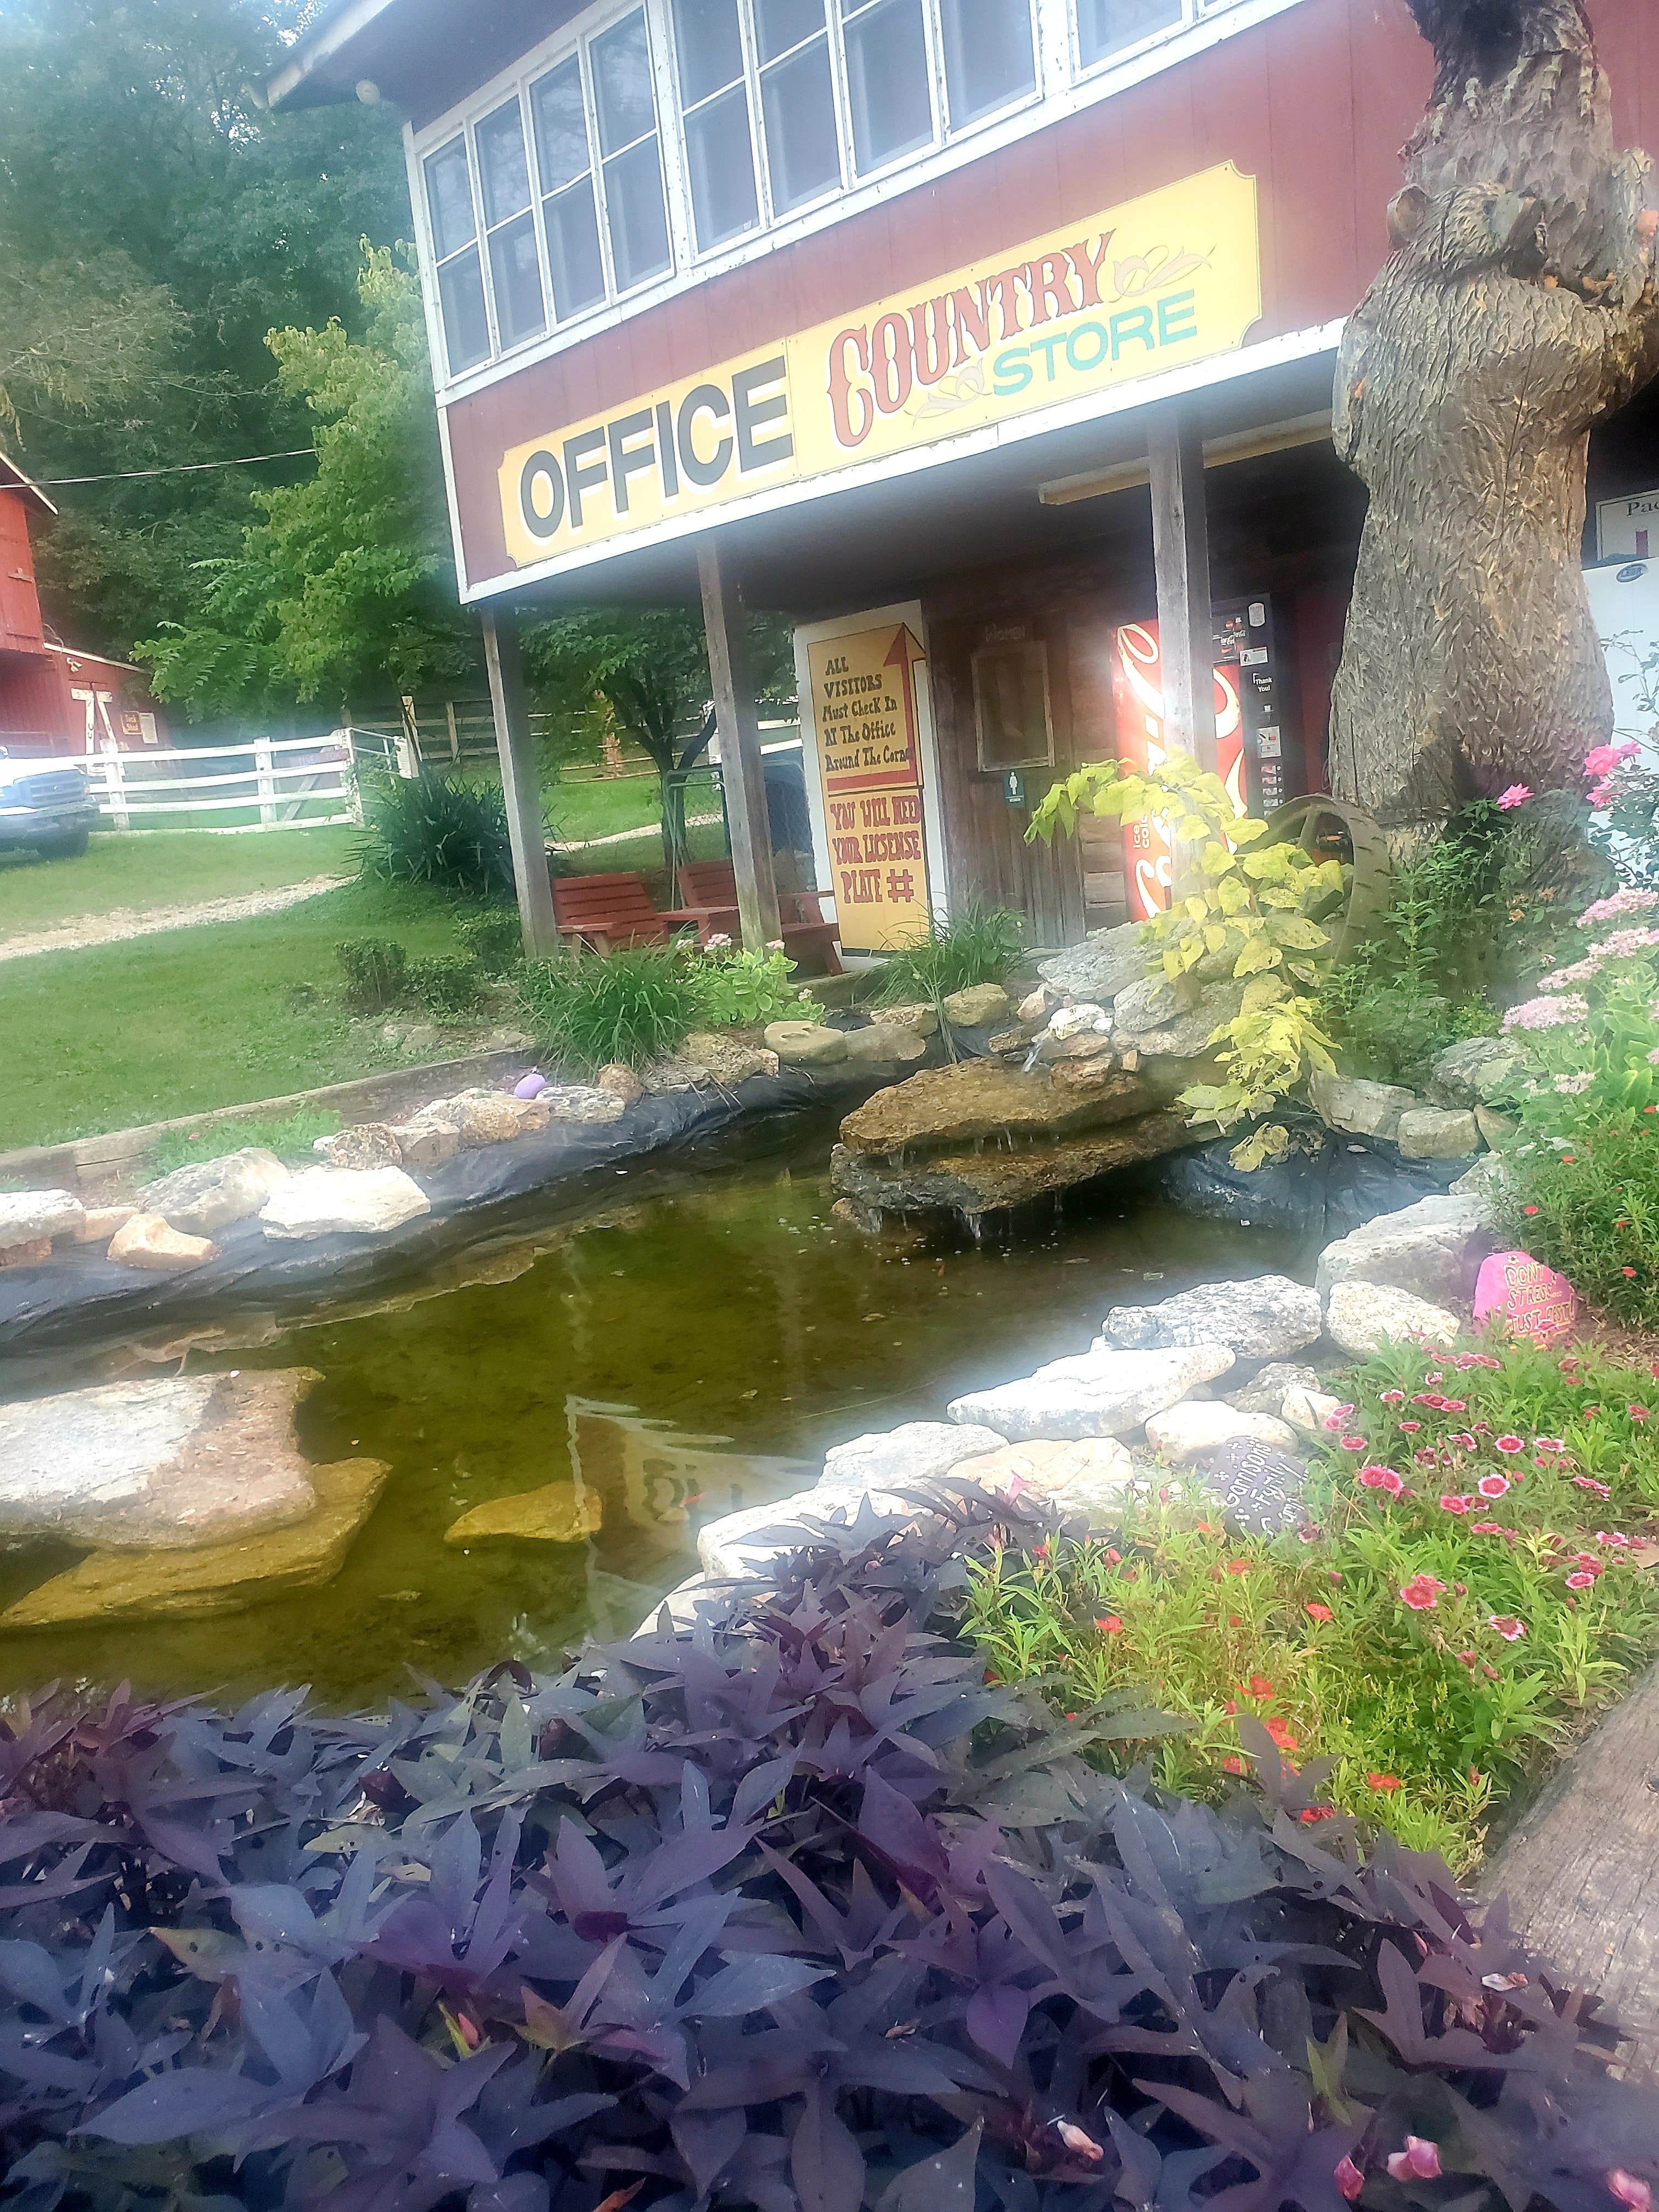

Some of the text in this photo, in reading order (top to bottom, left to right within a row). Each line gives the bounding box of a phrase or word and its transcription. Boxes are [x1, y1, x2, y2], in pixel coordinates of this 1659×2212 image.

[827, 228, 1116, 448] COUNTRY
[992, 289, 1198, 398] STORE
[520, 356, 795, 539] OFFICE
[825, 656, 849, 676] ALL
[823, 674, 882, 699] VISITORS
[1255, 676, 1273, 685] Thank
[822, 703, 849, 722] Must
[884, 696, 898, 712] In
[840, 725, 860, 744] The
[862, 720, 896, 741] Office
[825, 749, 860, 772] Around
[862, 746, 881, 766] The
[830, 795, 921, 831] YOU WILL NEED
[832, 837, 864, 865] YOUR
[840, 868, 915, 904] PLATE #
